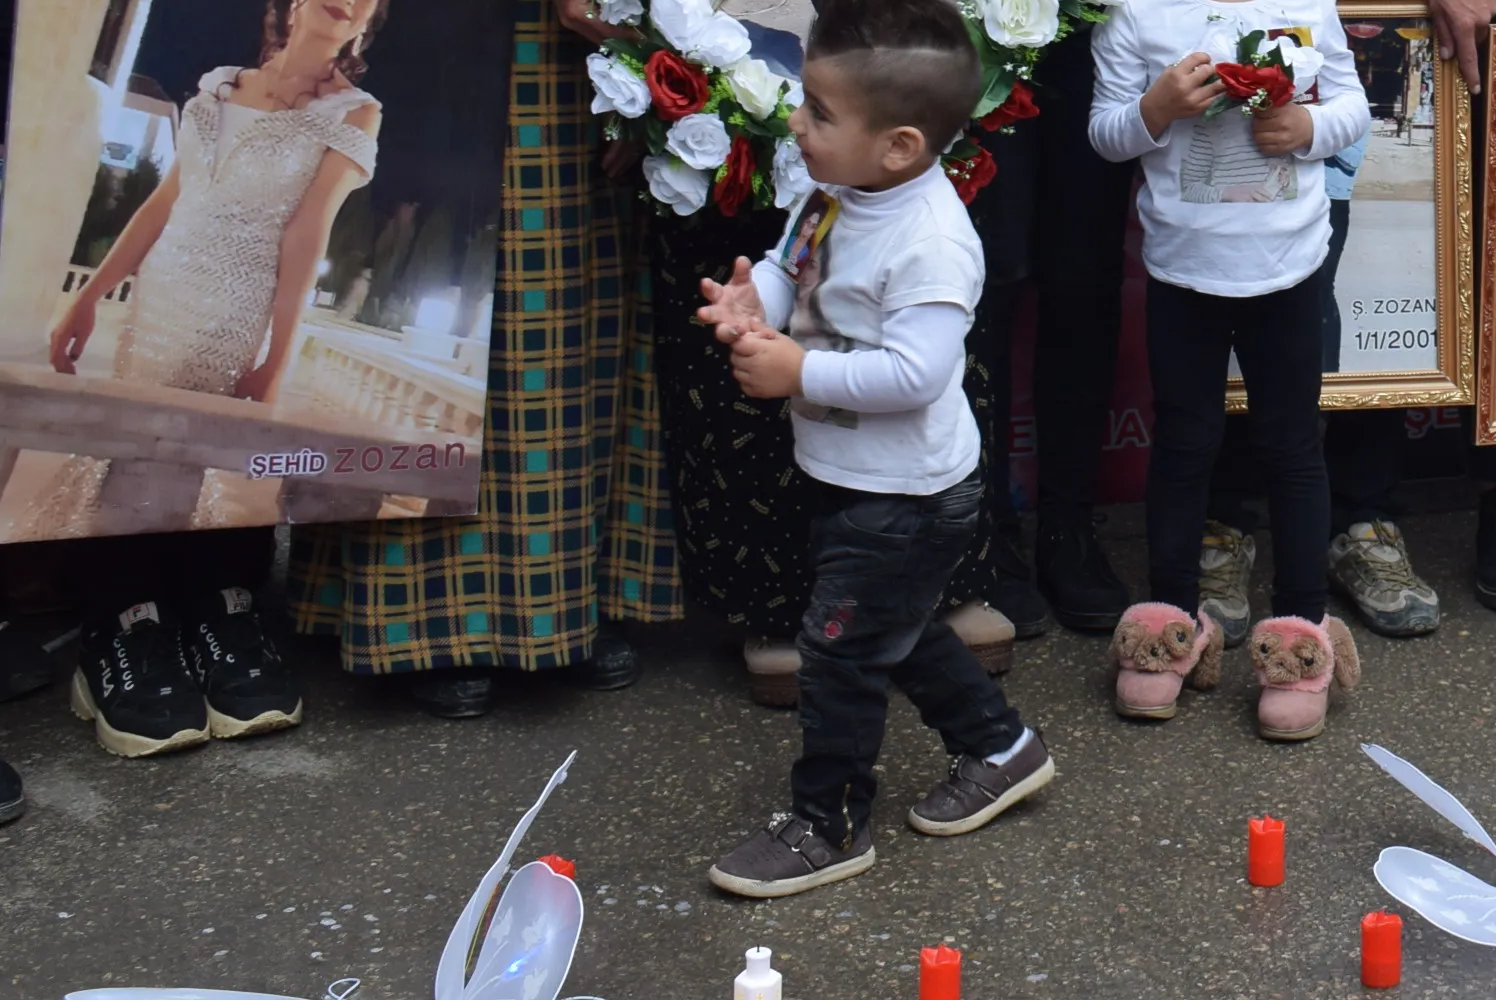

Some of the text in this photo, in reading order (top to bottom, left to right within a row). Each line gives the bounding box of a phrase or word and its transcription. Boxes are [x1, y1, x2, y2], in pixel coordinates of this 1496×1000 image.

[1374, 298, 1437, 315] ZOZAN
[1354, 330, 1437, 350] 1/1/2001
[251, 441, 467, 480] ŞEHÎD zozan
